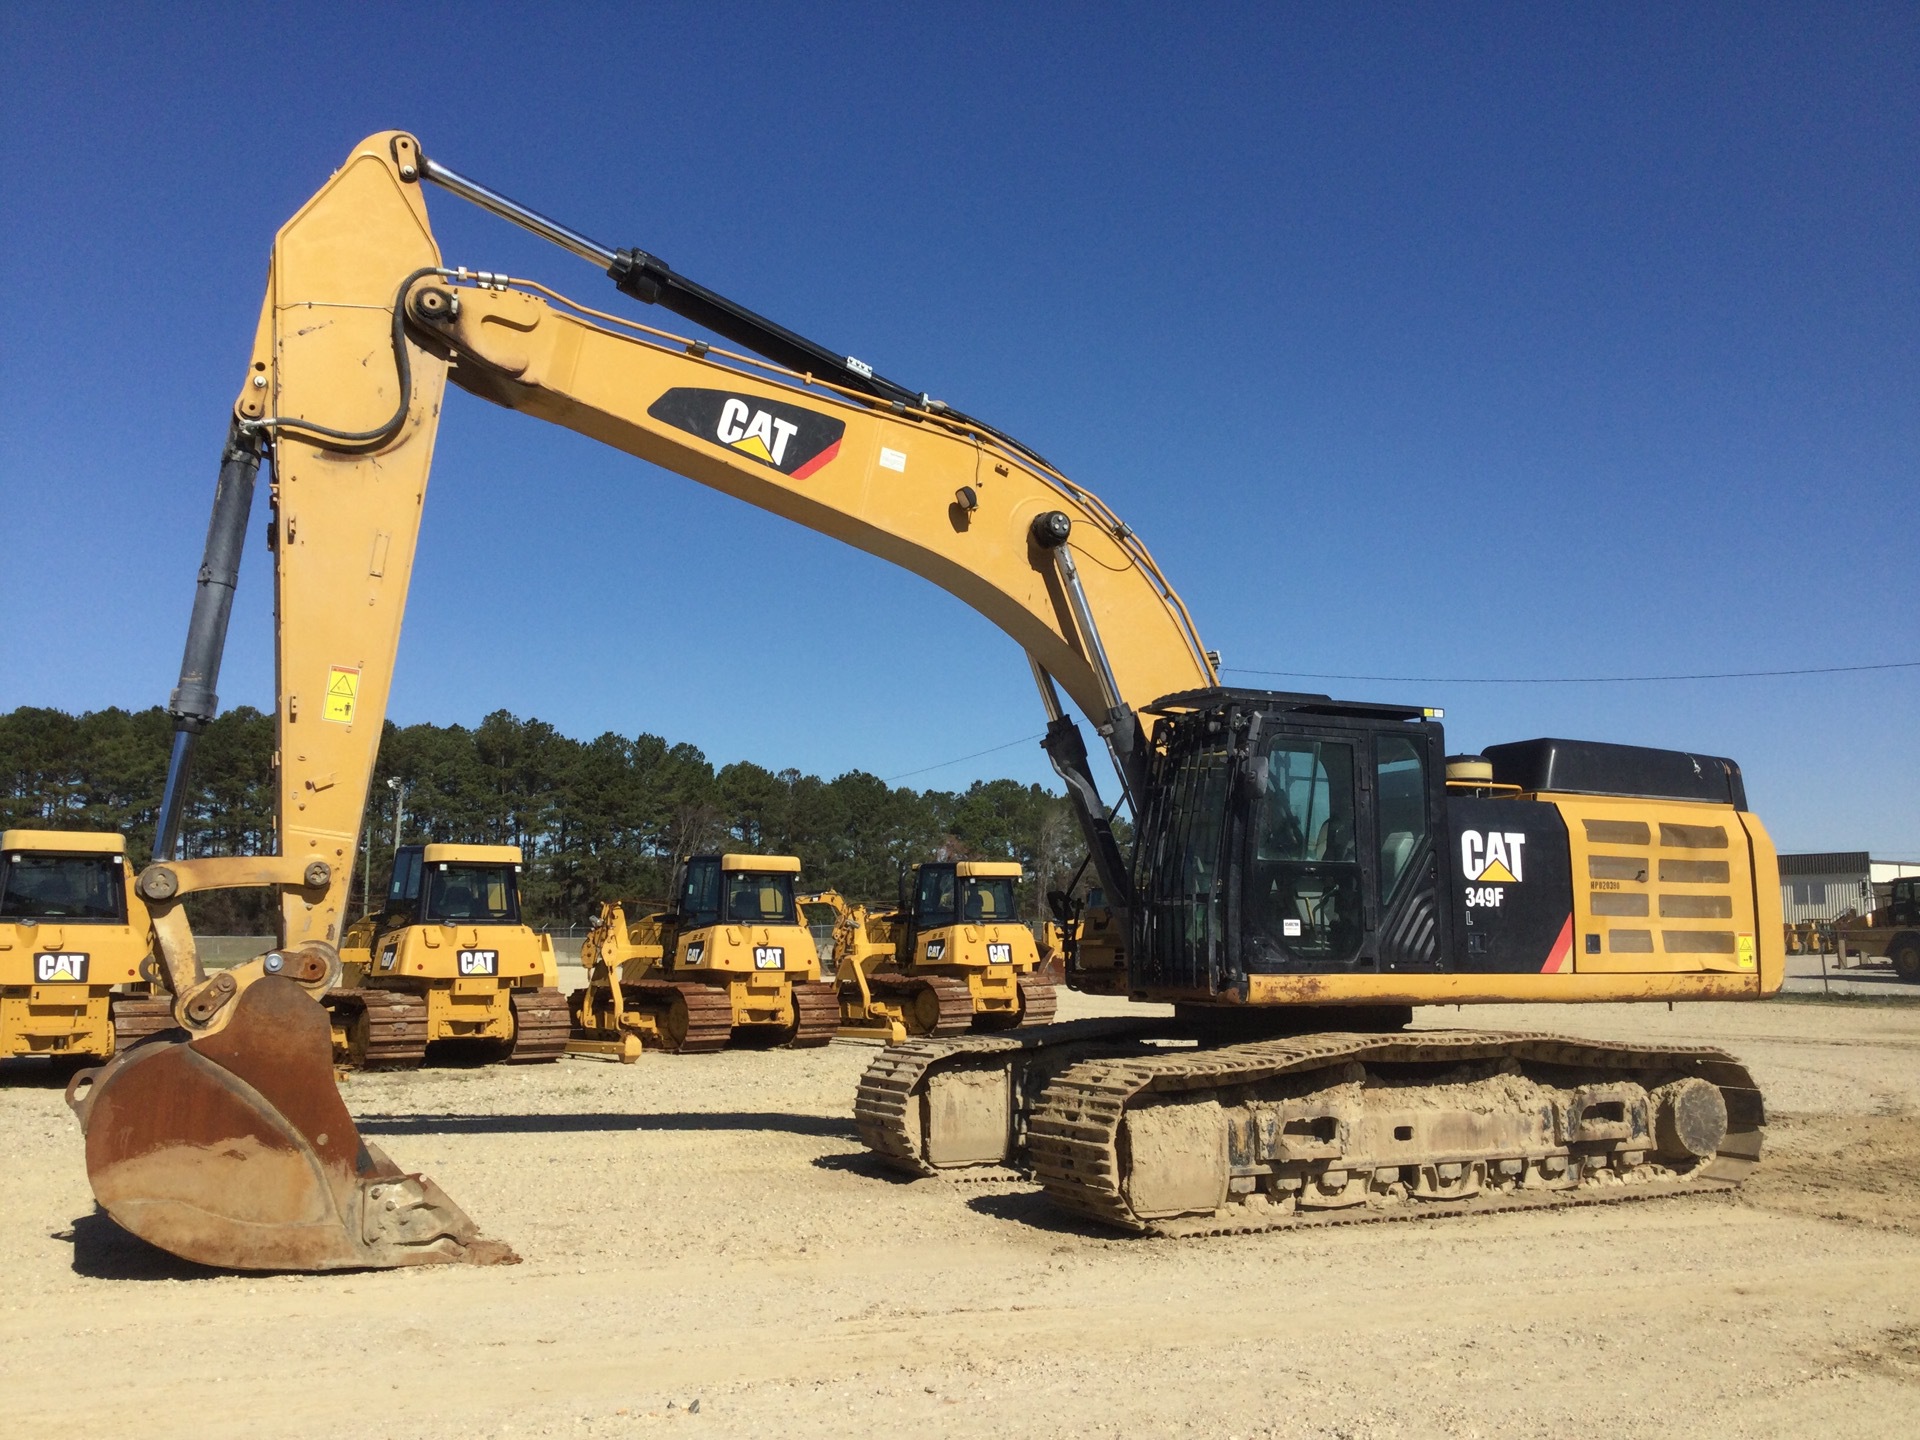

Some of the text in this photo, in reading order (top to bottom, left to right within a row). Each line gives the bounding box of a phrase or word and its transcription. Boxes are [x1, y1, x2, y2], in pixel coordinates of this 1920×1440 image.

[717, 398, 798, 466] CAT
[1461, 830, 1525, 882] CAT
[1465, 887, 1503, 907] 349F
[1465, 911, 1474, 926] L
[381, 952, 394, 967] CAT
[686, 948, 700, 961] CAT
[755, 948, 782, 969] CAT
[927, 945, 941, 958] CAT
[988, 945, 1010, 963] CAT
[39, 955, 85, 981] CAT
[460, 952, 495, 974] CAT
